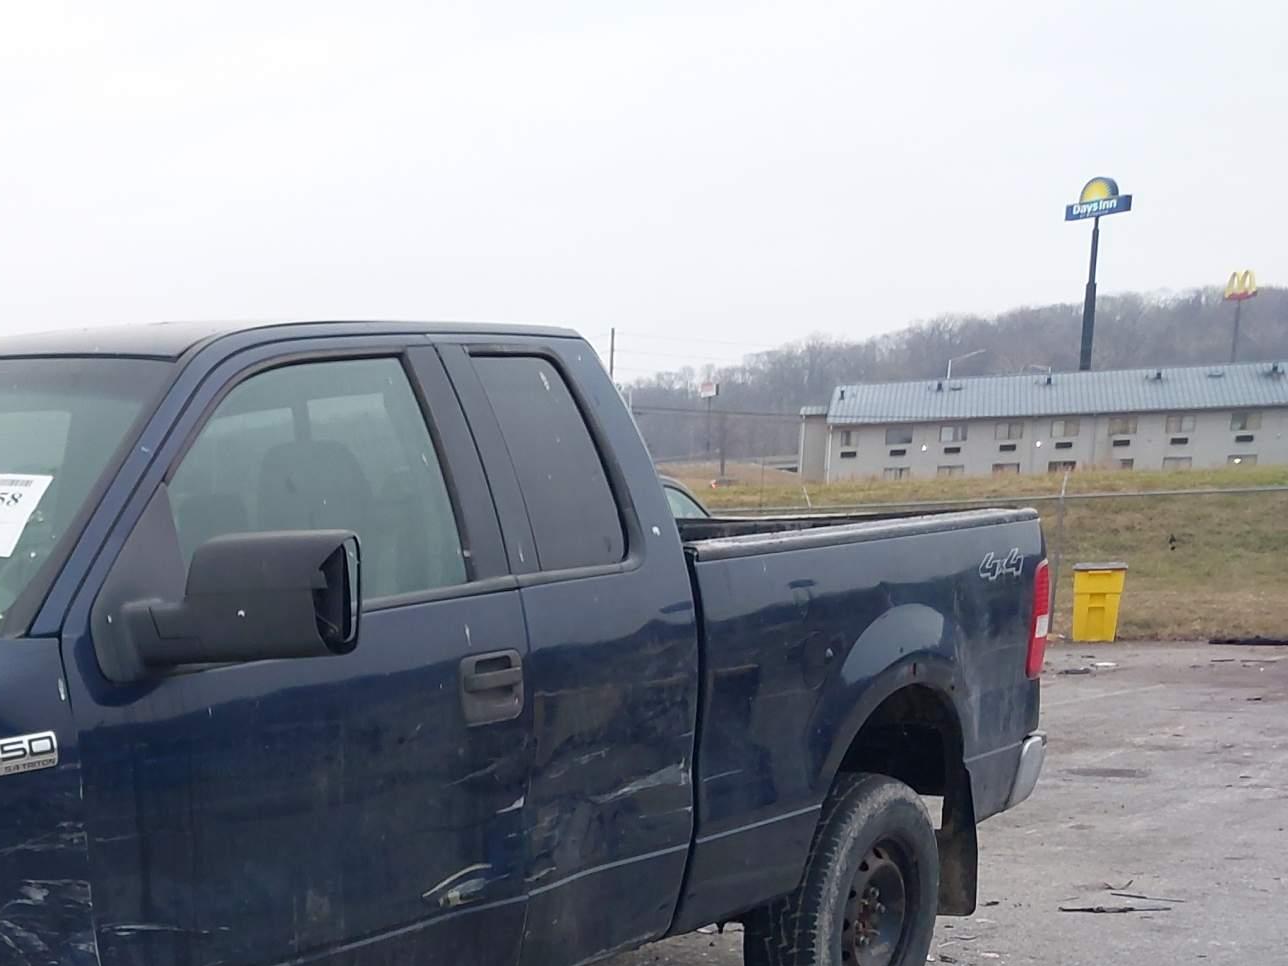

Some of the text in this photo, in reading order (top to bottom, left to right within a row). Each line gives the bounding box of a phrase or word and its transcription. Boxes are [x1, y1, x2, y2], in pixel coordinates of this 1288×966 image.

[1072, 202, 1098, 217] Days
[1099, 199, 1118, 210] Inn
[979, 548, 1024, 580] 4x4
